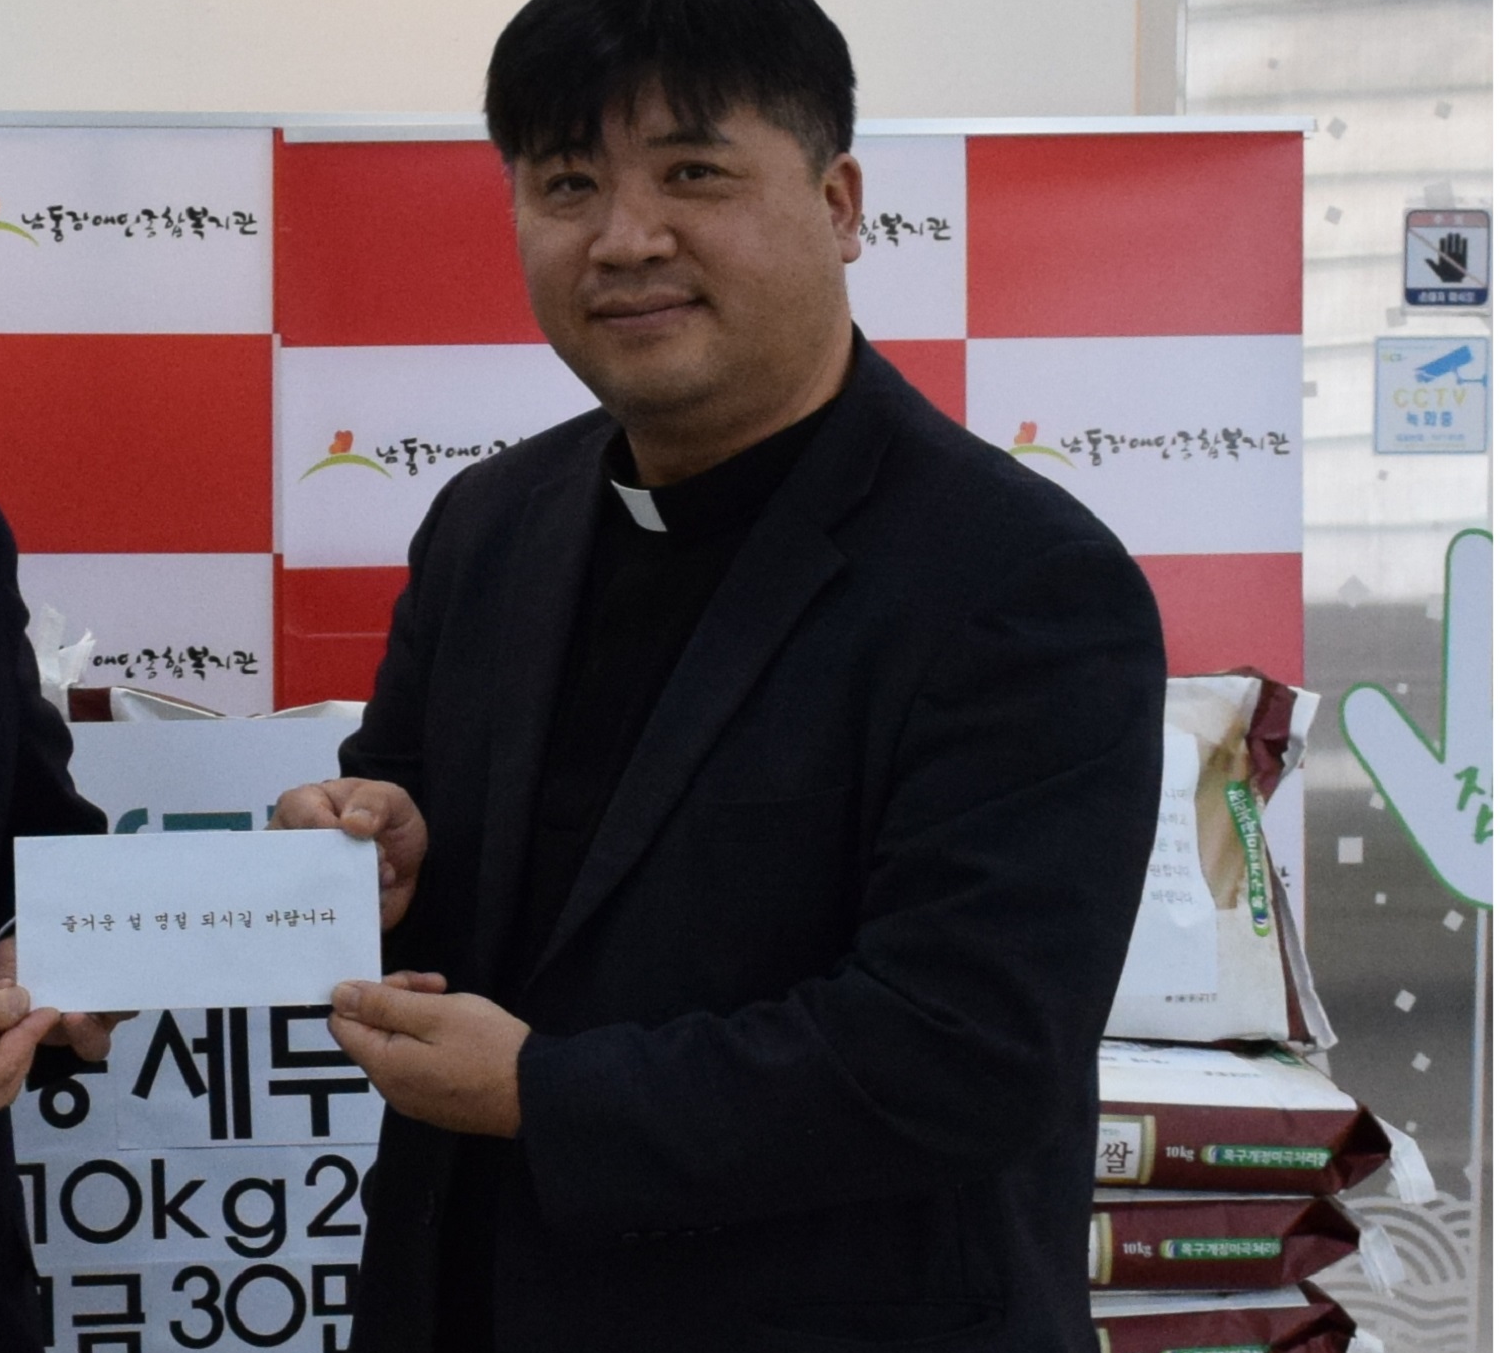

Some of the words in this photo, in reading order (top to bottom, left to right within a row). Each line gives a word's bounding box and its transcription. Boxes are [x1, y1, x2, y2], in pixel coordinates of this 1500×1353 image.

[21, 204, 258, 243] 남동장애인종합복지관
[1393, 387, 1467, 408] CCTV
[1059, 427, 1291, 466] 남동장애인종합복지관
[61, 913, 116, 933] 즐거운
[127, 913, 142, 931] 설
[155, 911, 187, 931] 명절
[201, 910, 252, 931] 되시길
